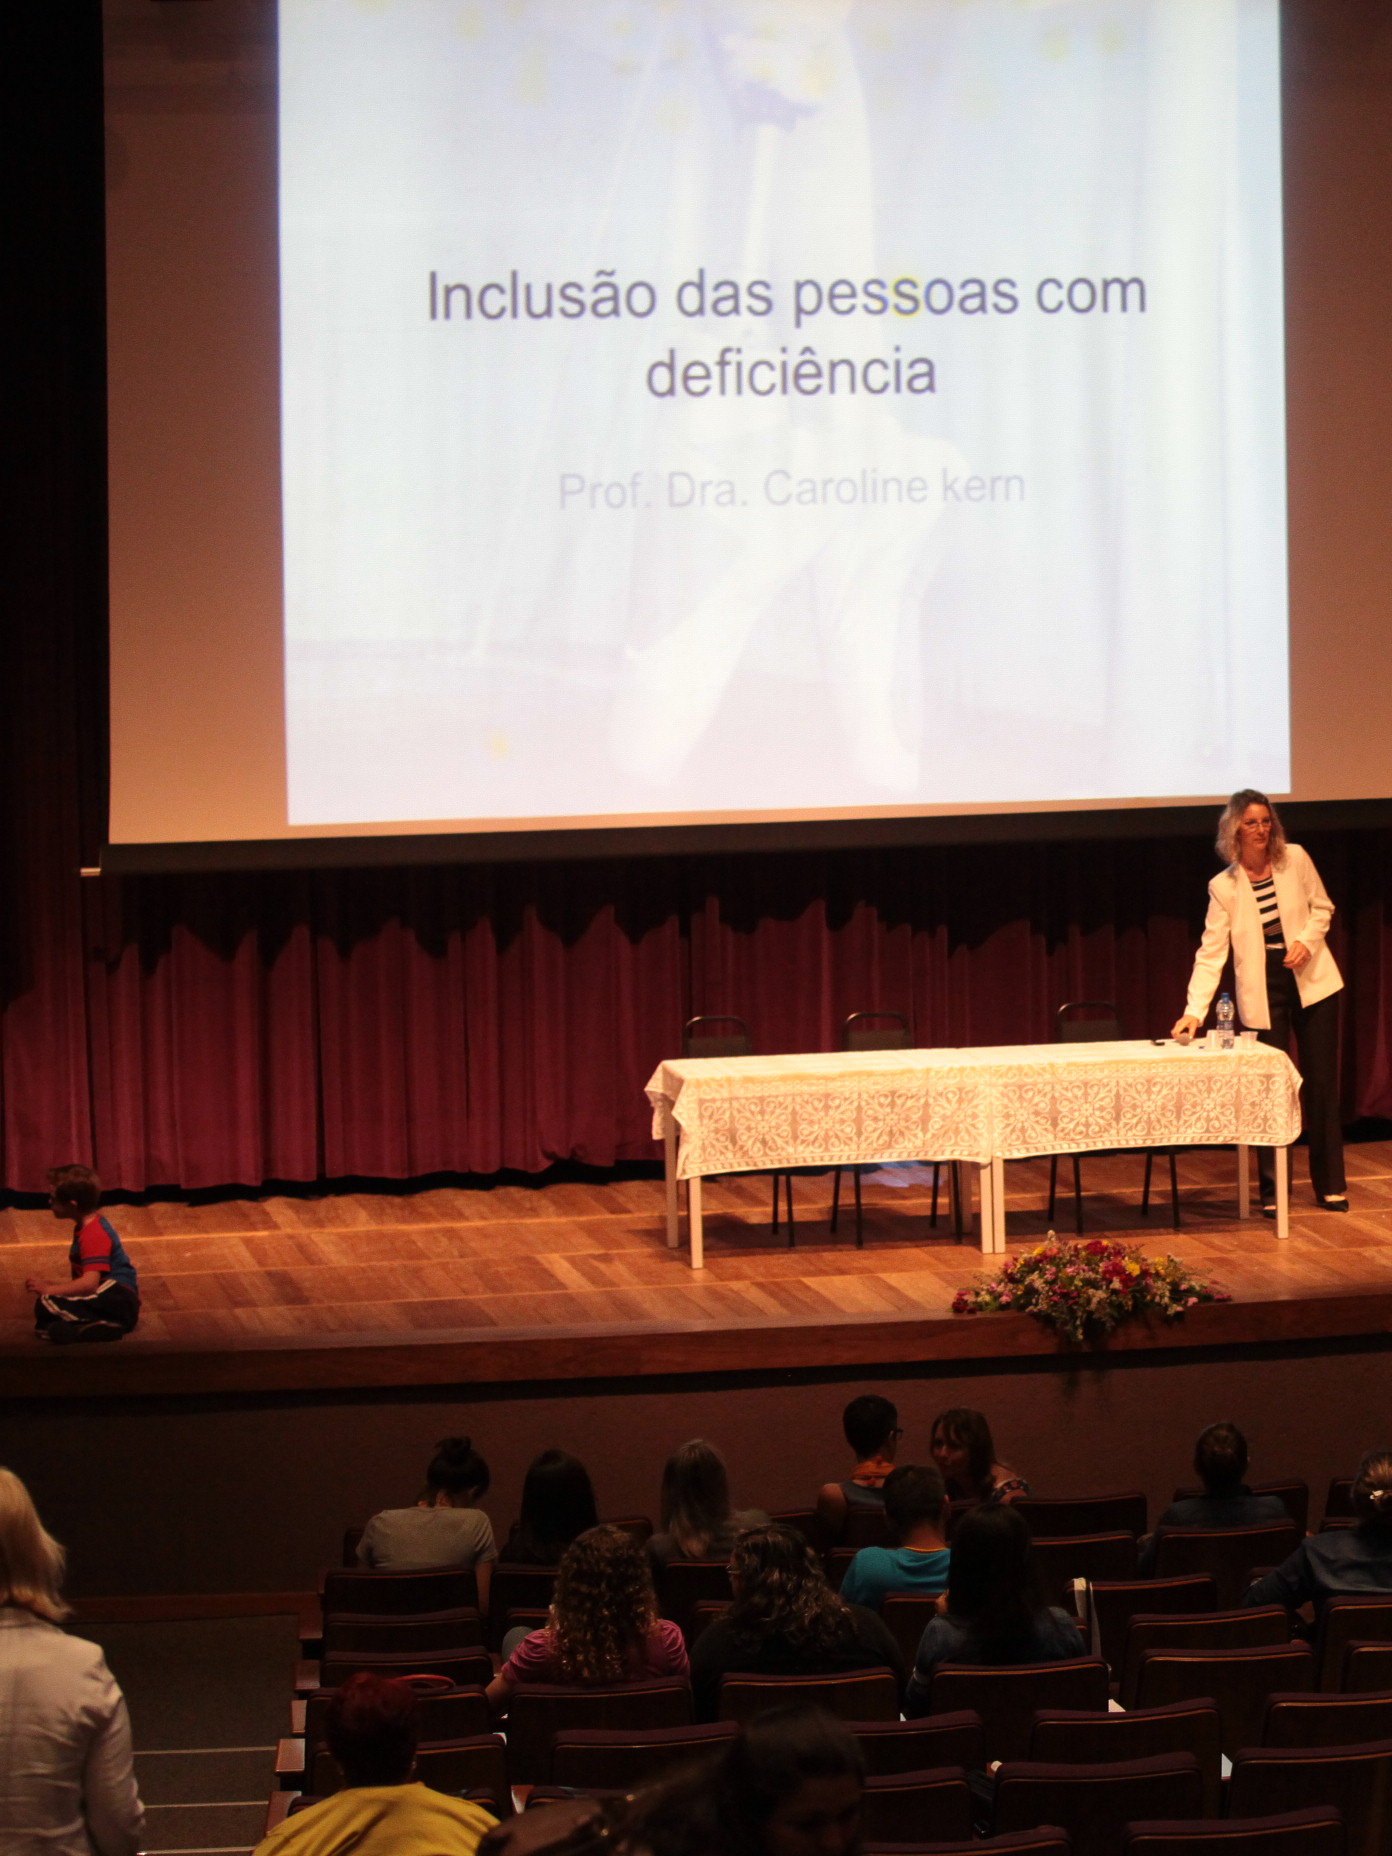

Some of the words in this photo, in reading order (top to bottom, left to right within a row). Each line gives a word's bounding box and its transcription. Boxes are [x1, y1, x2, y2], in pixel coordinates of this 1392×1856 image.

[428, 269, 657, 321] Inclusão
[676, 268, 774, 318] das
[795, 277, 1020, 328] pessoas
[1036, 276, 1148, 315] com
[647, 346, 938, 398] deficiência
[559, 473, 651, 510] Prof.
[668, 472, 749, 508] Dra.
[764, 468, 928, 506] Caroline
[942, 467, 1027, 504] kern
